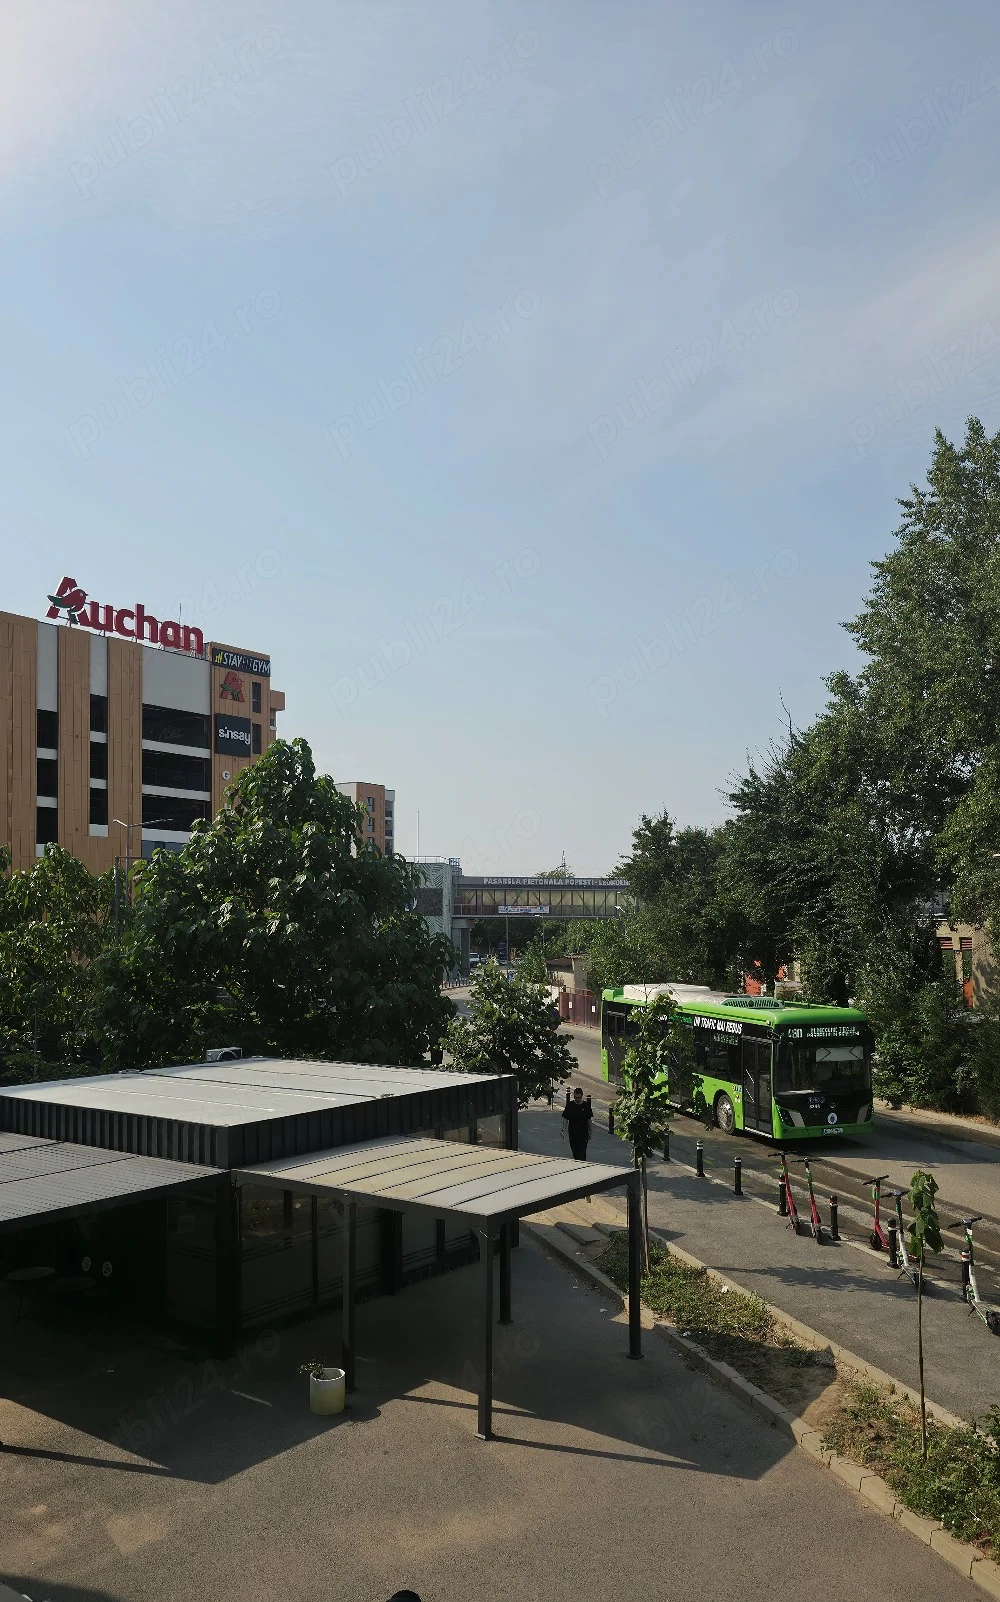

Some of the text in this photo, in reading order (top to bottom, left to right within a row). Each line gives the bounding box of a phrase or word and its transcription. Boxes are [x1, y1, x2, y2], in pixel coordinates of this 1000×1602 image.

[46, 576, 204, 655] Auchan
[223, 652, 242, 668] STAY
[252, 659, 270, 674] GYM
[218, 726, 251, 745] sinsay
[483, 877, 521, 885] PASARELA
[523, 878, 563, 886] PIETONALA
[701, 1017, 717, 1030] TRAFIC
[726, 1021, 743, 1034] REDUS
